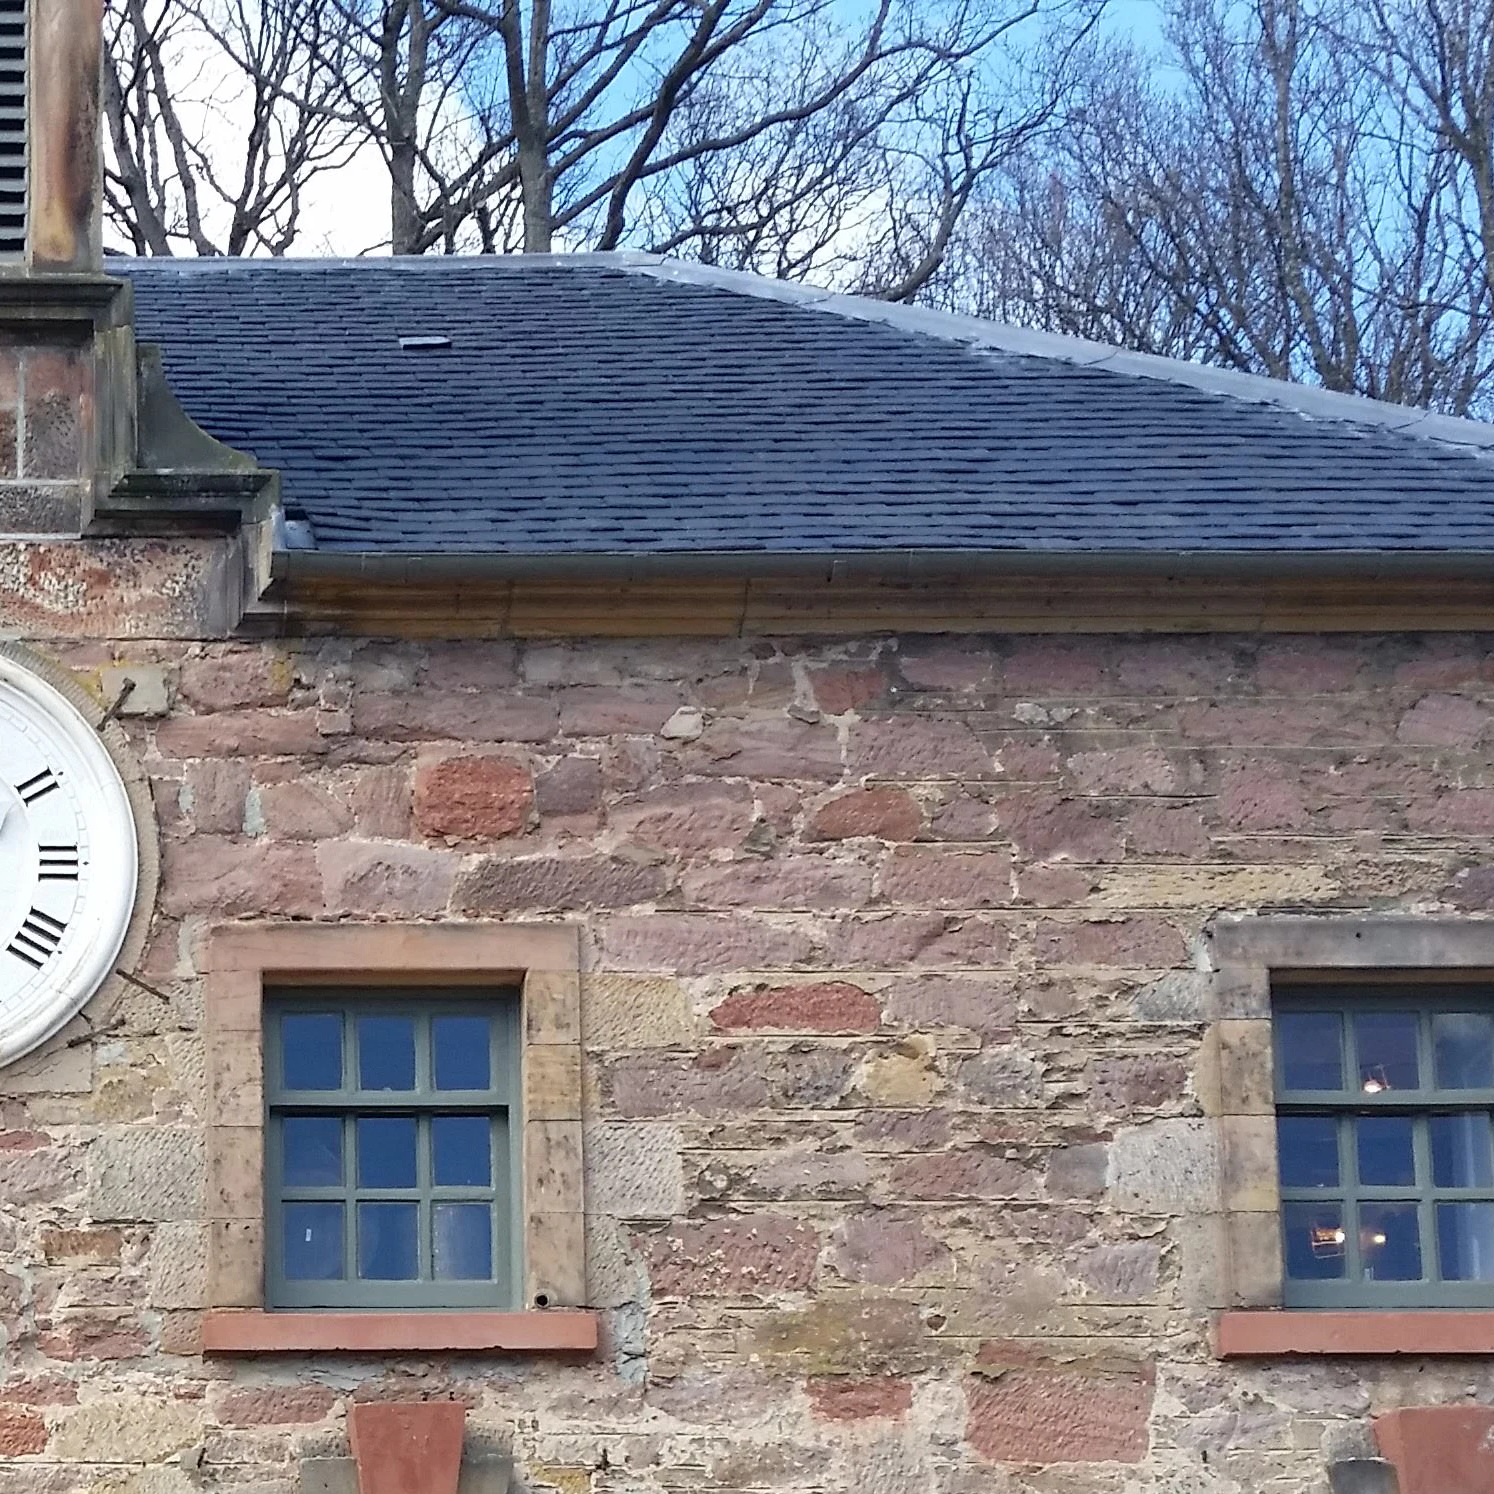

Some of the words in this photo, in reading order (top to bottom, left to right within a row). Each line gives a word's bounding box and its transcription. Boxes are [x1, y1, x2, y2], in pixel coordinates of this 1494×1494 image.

[14, 767, 60, 807] II
[38, 842, 79, 882] III
[6, 906, 68, 970] IIII
